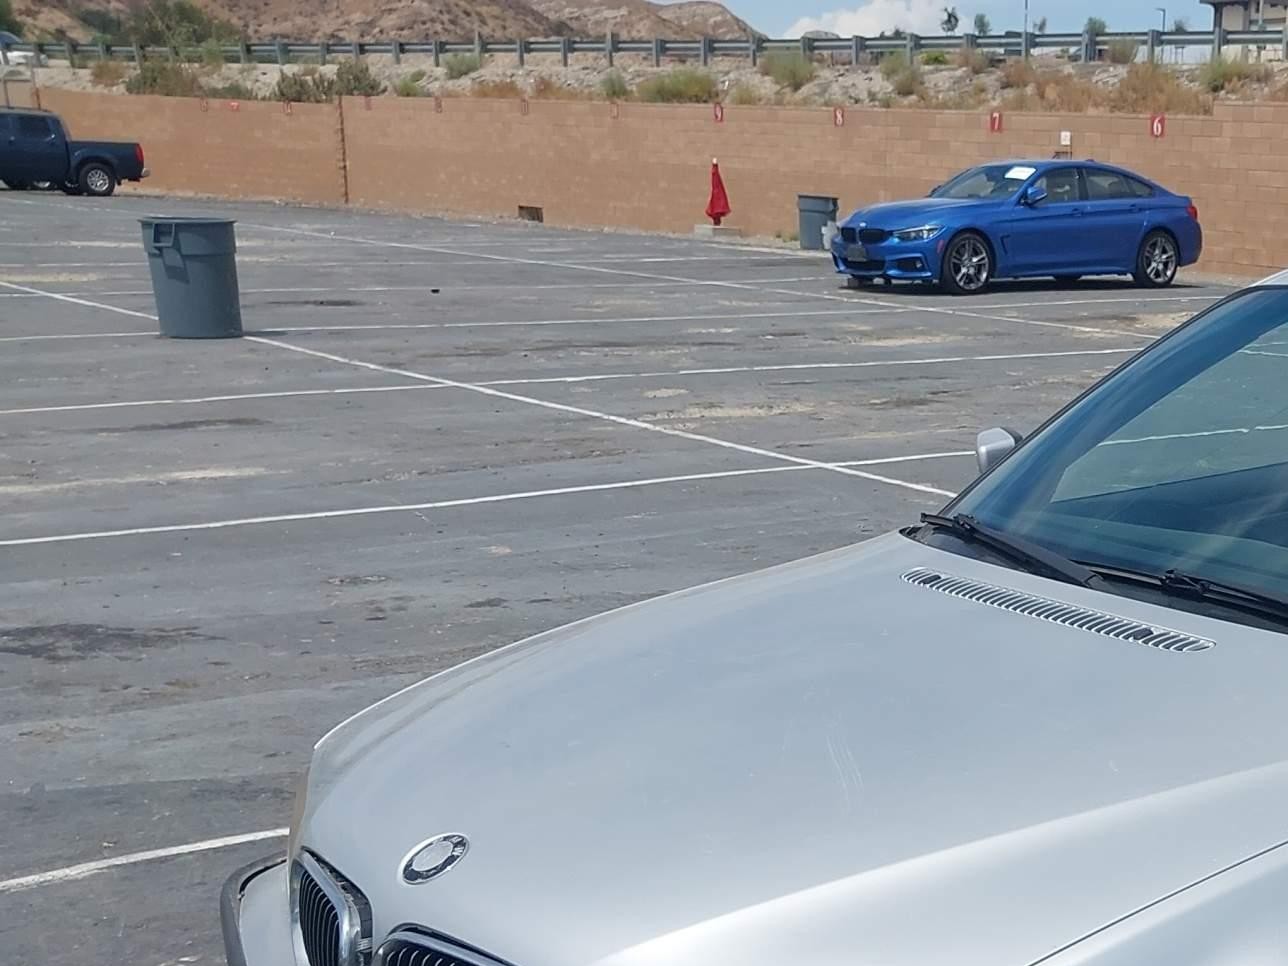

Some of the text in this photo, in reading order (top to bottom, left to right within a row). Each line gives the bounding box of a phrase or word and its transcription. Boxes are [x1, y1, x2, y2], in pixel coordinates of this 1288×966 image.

[835, 108, 844, 126] 8
[992, 112, 1000, 131] 7
[1153, 116, 1162, 137] 6
